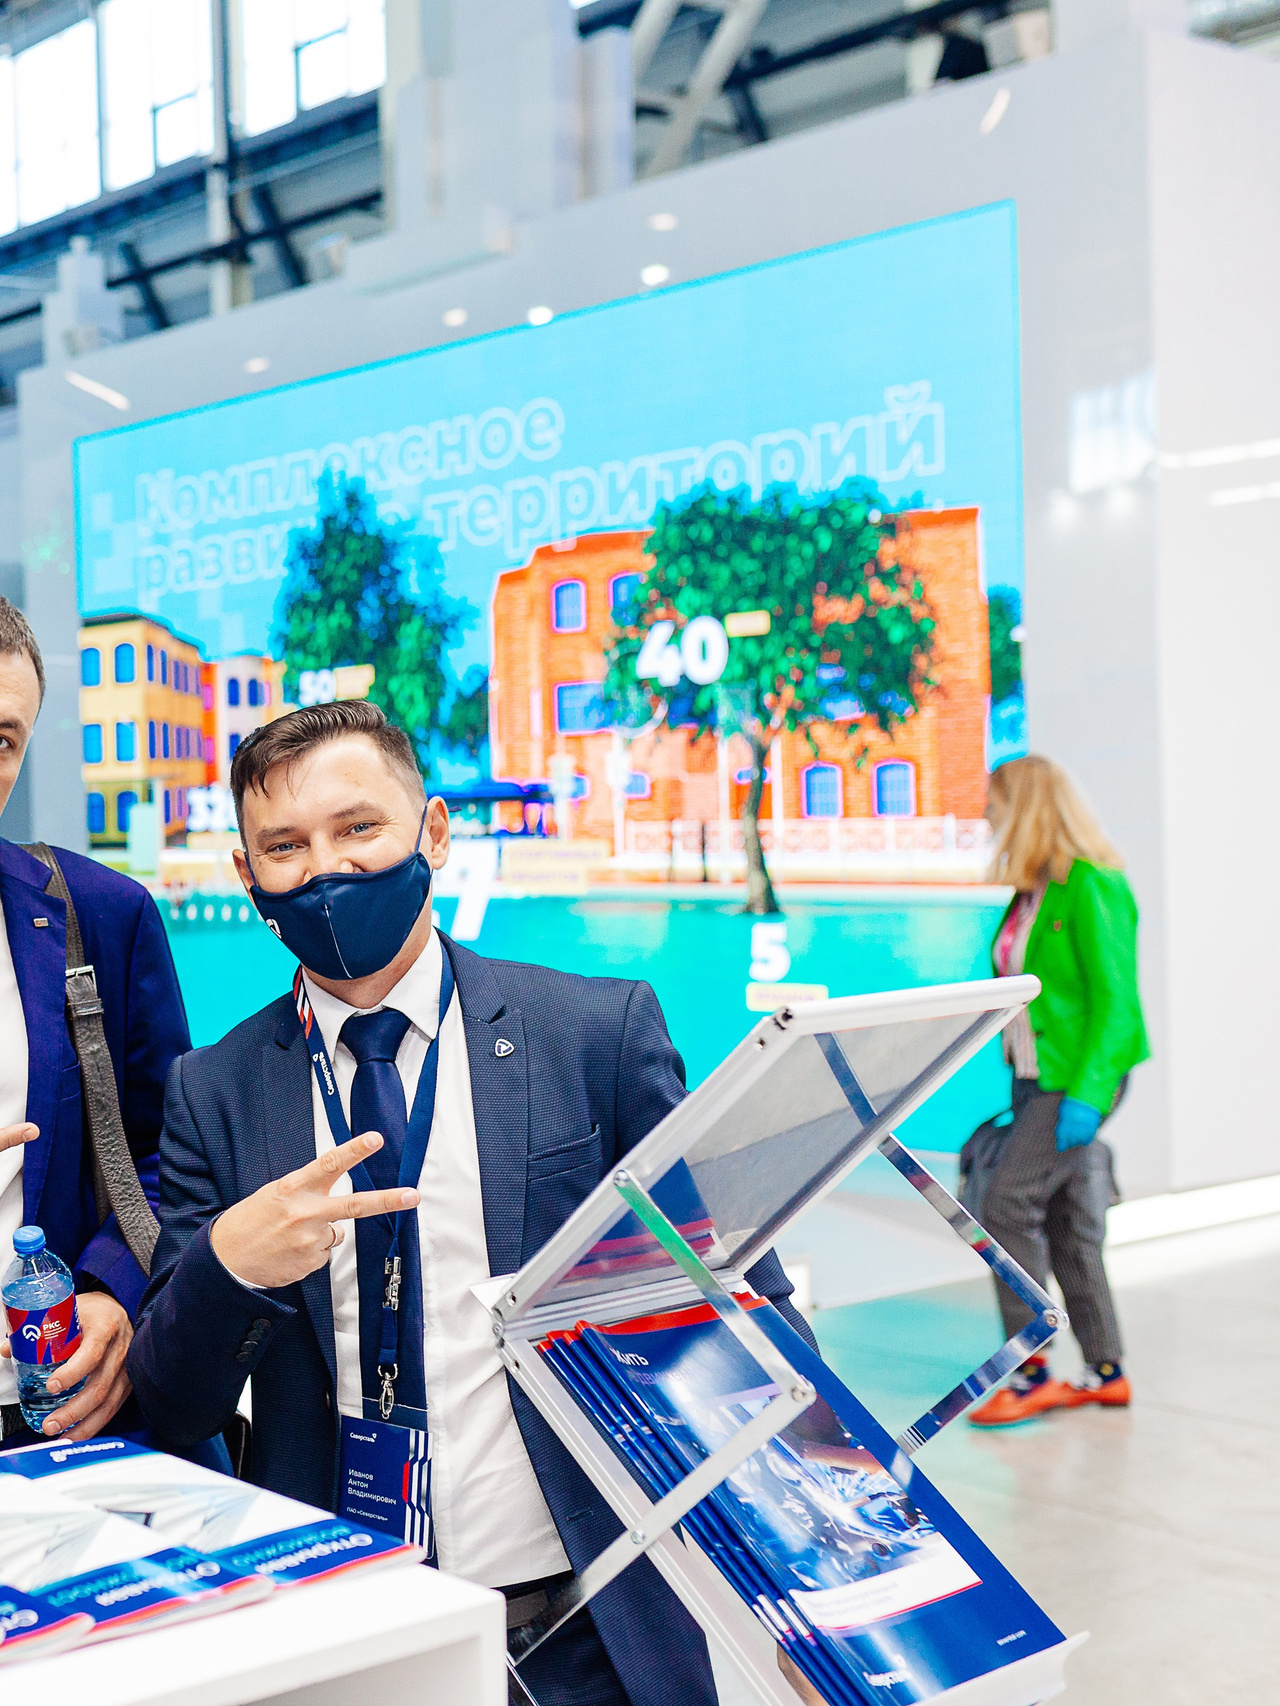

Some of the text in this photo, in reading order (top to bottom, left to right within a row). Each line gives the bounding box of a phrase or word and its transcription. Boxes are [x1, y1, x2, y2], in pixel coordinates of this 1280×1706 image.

[422, 379, 946, 558] территорий
[635, 614, 729, 688] 40
[748, 921, 791, 983] 5
[347, 1478, 369, 1489] Антон
[348, 1468, 374, 1481] Иванов
[347, 1487, 397, 1505] Владимирович
[346, 1506, 357, 1514] ПАО
